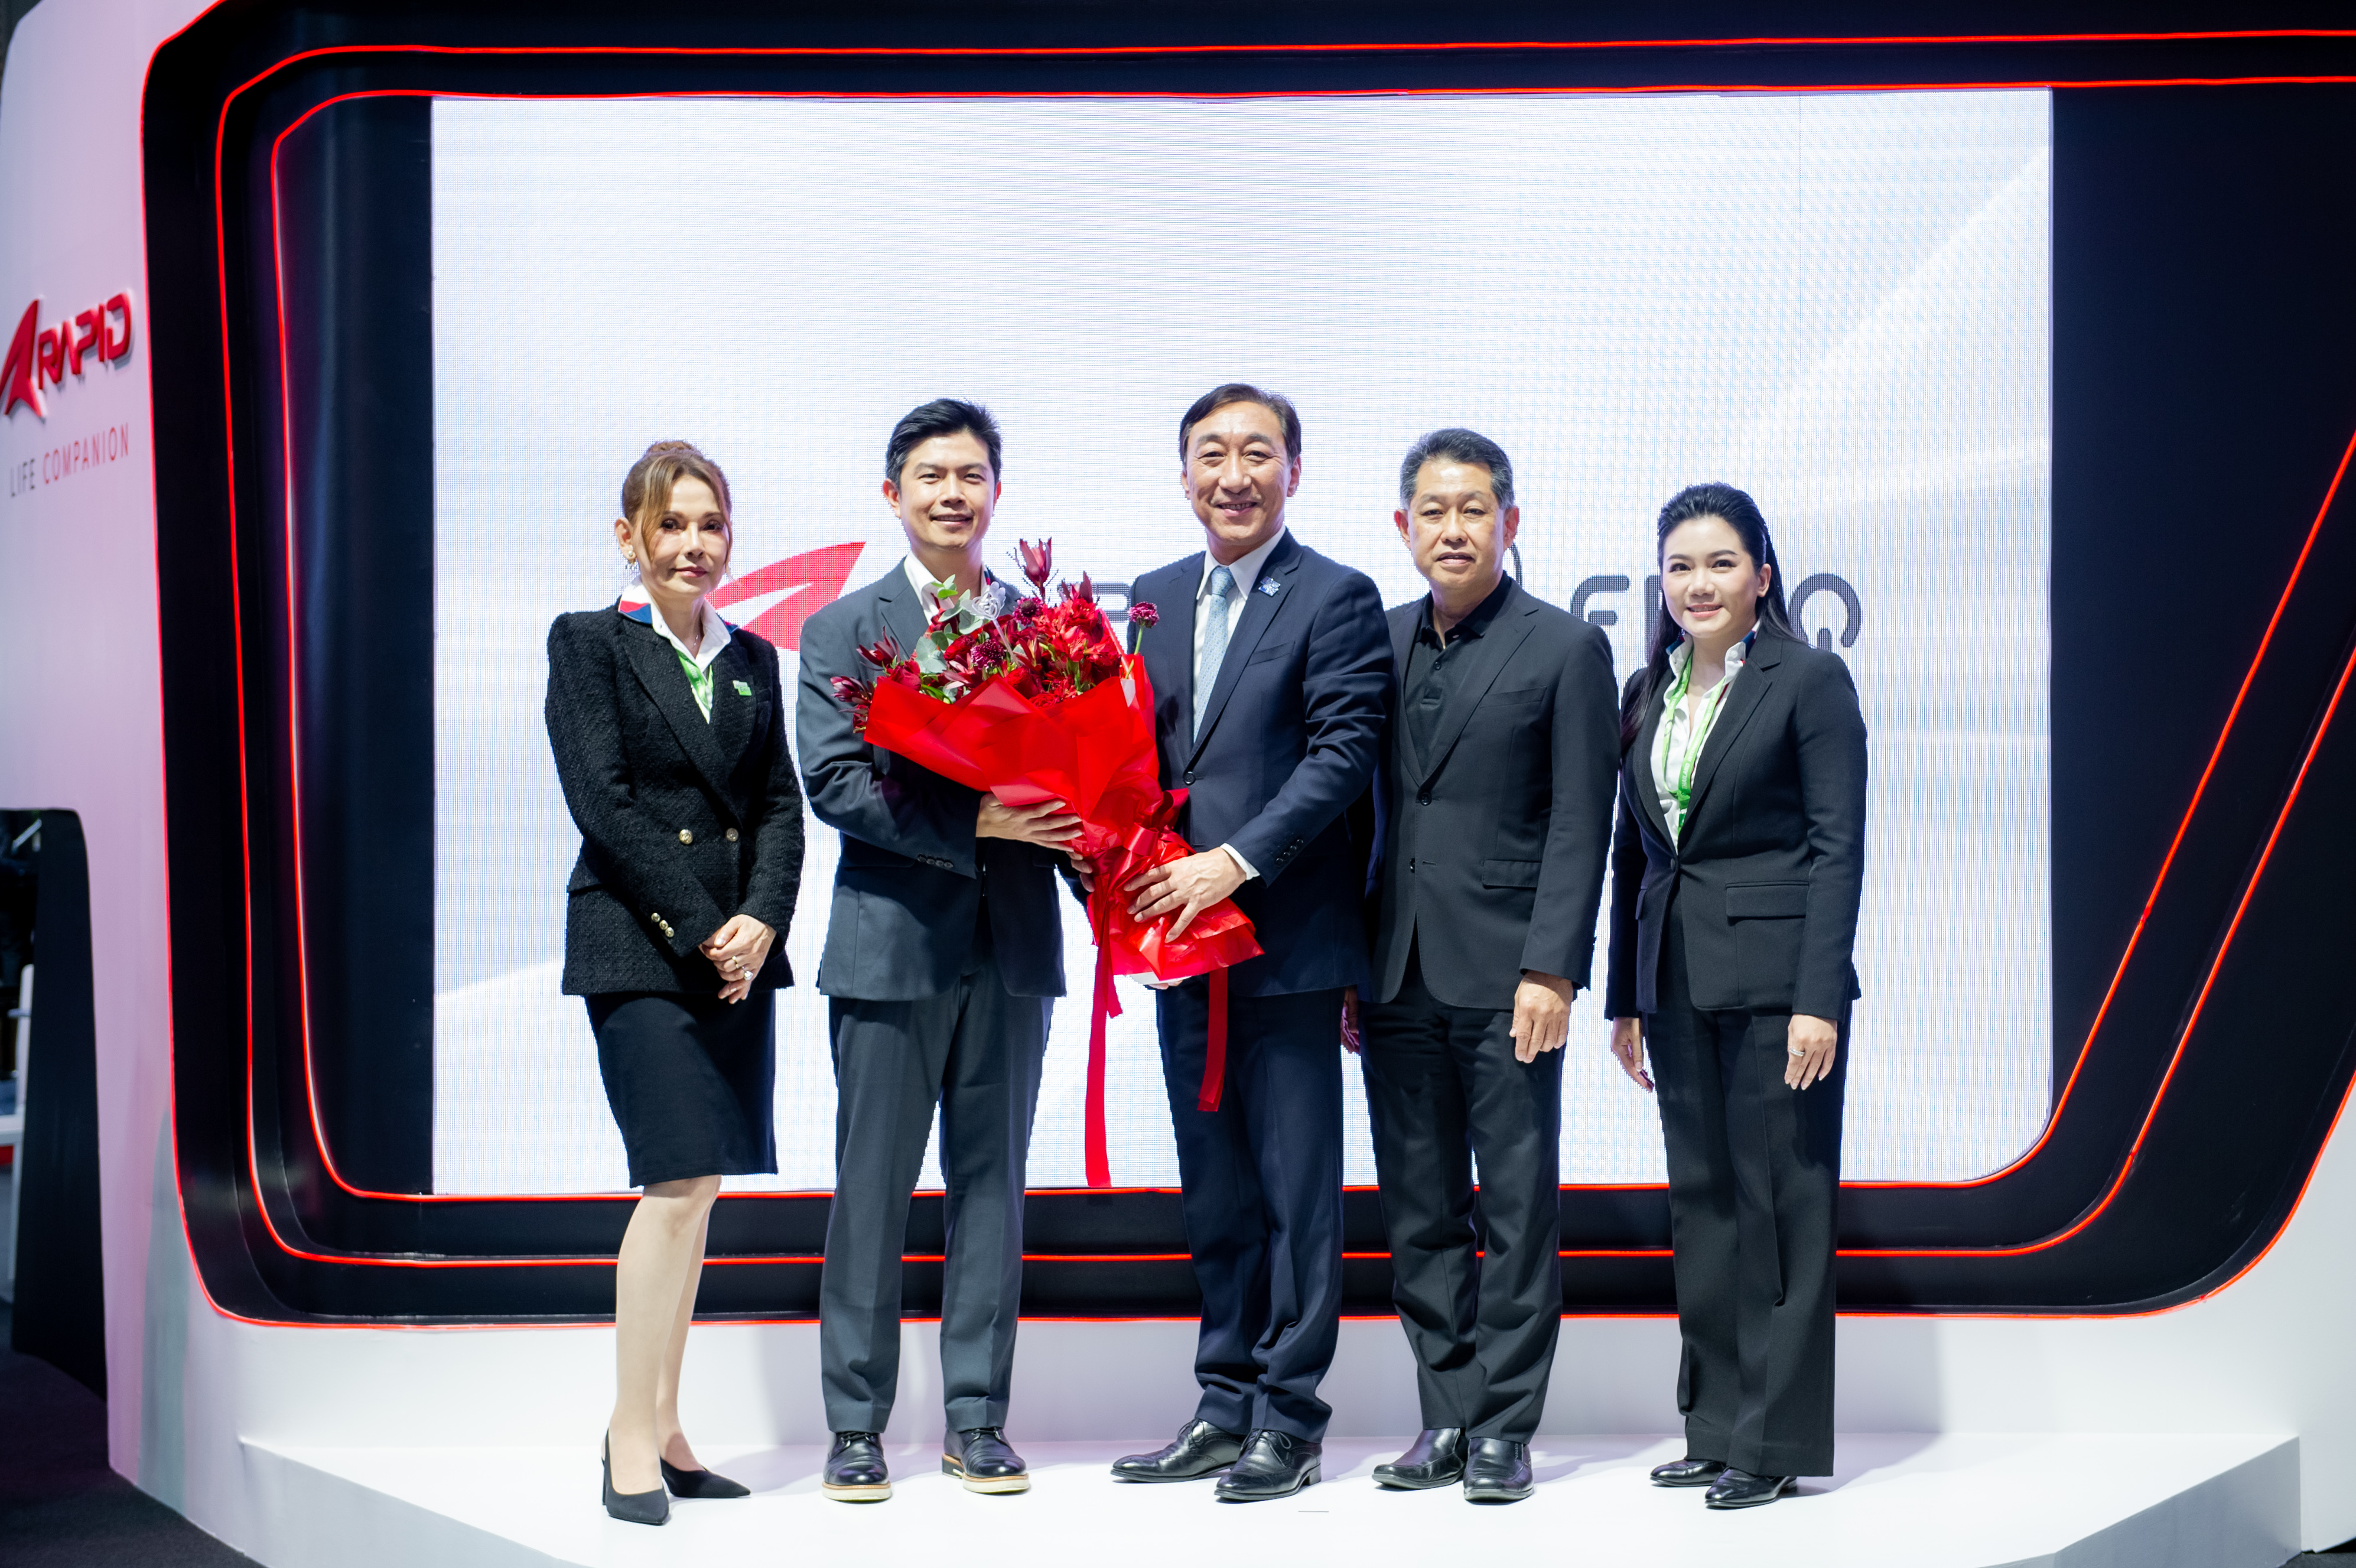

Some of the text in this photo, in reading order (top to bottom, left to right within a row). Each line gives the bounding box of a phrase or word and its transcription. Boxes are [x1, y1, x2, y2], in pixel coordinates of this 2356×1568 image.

[10, 422, 129, 497] LIFE COMPANION
[1681, 763, 1690, 789] THAILAND
